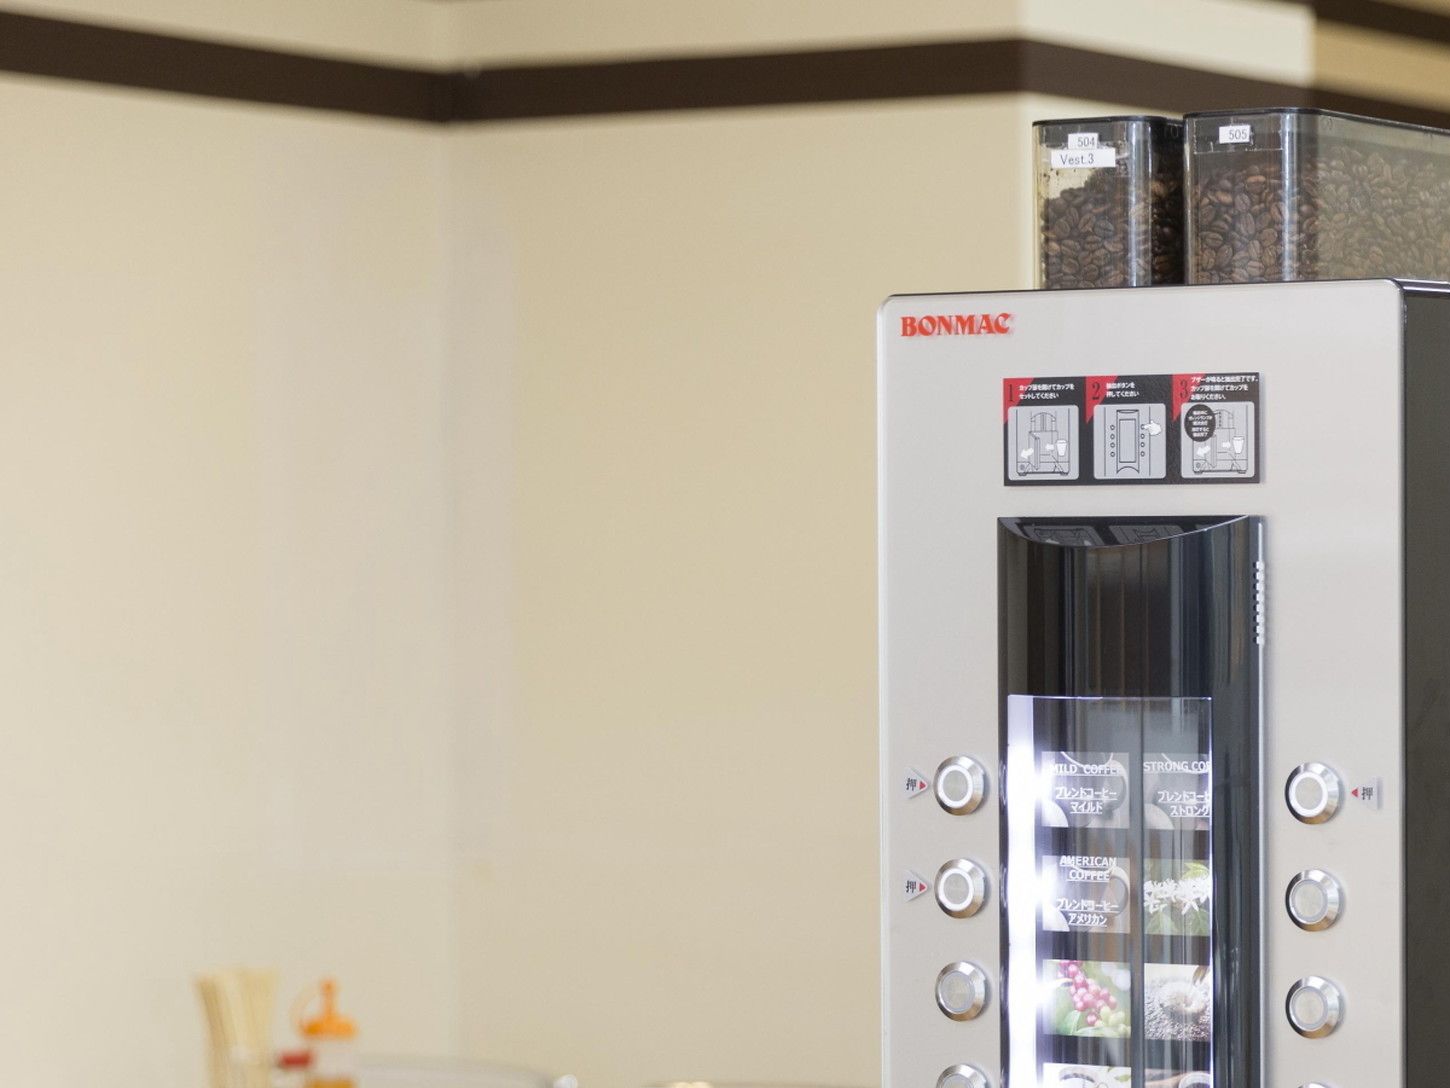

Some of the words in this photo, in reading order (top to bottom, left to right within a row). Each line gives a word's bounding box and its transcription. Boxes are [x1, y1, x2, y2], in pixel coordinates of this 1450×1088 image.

[1228, 128, 1248, 140] 505
[1077, 135, 1096, 148] 504
[901, 312, 1013, 337] BONMAC
[1092, 381, 1100, 400] 2
[1180, 379, 1188, 399] 3
[1051, 764, 1078, 775] MILD
[1143, 761, 1189, 772] STRONG
[1070, 801, 1103, 813] マイルド
[1060, 855, 1118, 867] AMERICAN
[1069, 869, 1110, 881] COFFEE
[1068, 913, 1108, 926] アメリカン
